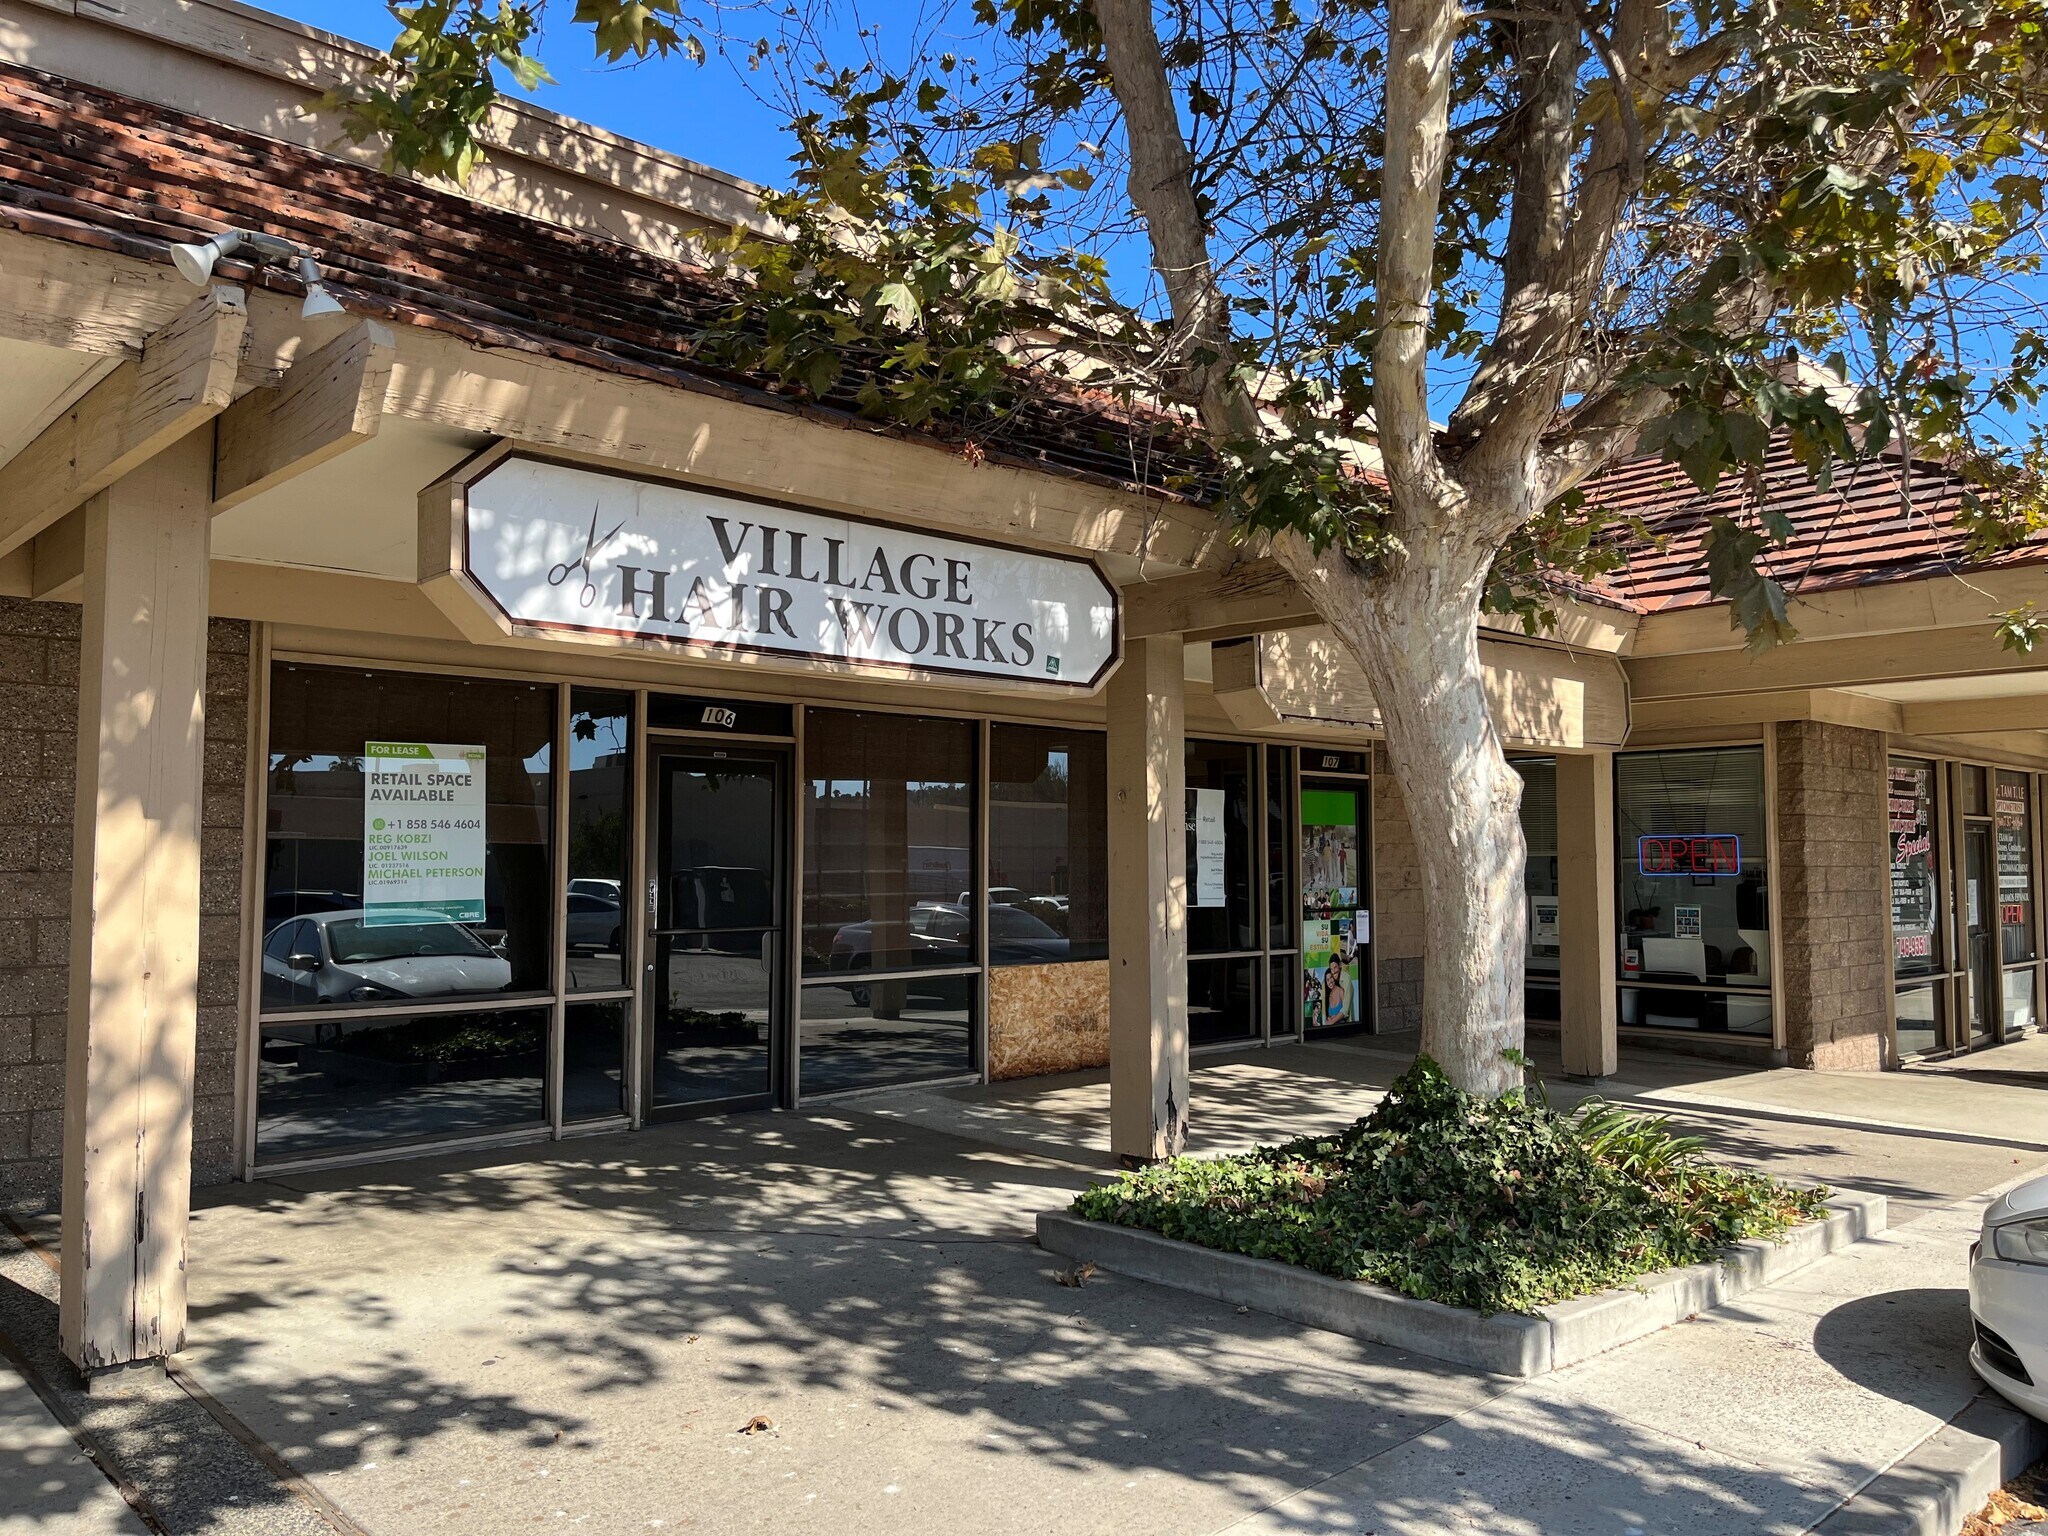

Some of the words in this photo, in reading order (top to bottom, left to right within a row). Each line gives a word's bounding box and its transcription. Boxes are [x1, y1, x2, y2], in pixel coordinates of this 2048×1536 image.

[706, 515, 973, 606] VILLAGE
[616, 564, 798, 639] HAIR
[828, 597, 1035, 667] WORKS
[706, 708, 734, 726] 106
[371, 746, 390, 755] FOR
[392, 746, 419, 755] LEASE
[1324, 756, 1339, 767] 107
[371, 772, 422, 786] RETAIL
[427, 774, 472, 787] SPACE
[370, 788, 454, 802] AVAILABLE
[2000, 785, 2012, 798] TAM
[2018, 786, 2025, 800] LE
[387, 819, 402, 829] +1
[406, 819, 427, 830] 858
[430, 819, 451, 830] 546
[454, 819, 481, 829] 4604
[368, 834, 393, 844] REG
[396, 834, 432, 844] KOBZI
[1642, 838, 1737, 873] OPEN
[1896, 831, 1930, 865] Special
[368, 851, 397, 862] JOEL
[401, 851, 448, 861] WILSON
[368, 868, 422, 879] MICHAEL
[426, 867, 483, 878] PETERSON
[459, 911, 480, 919] CBRE
[2001, 905, 2023, 924] OPEN
[1896, 935, 1928, 958] 746-9351
